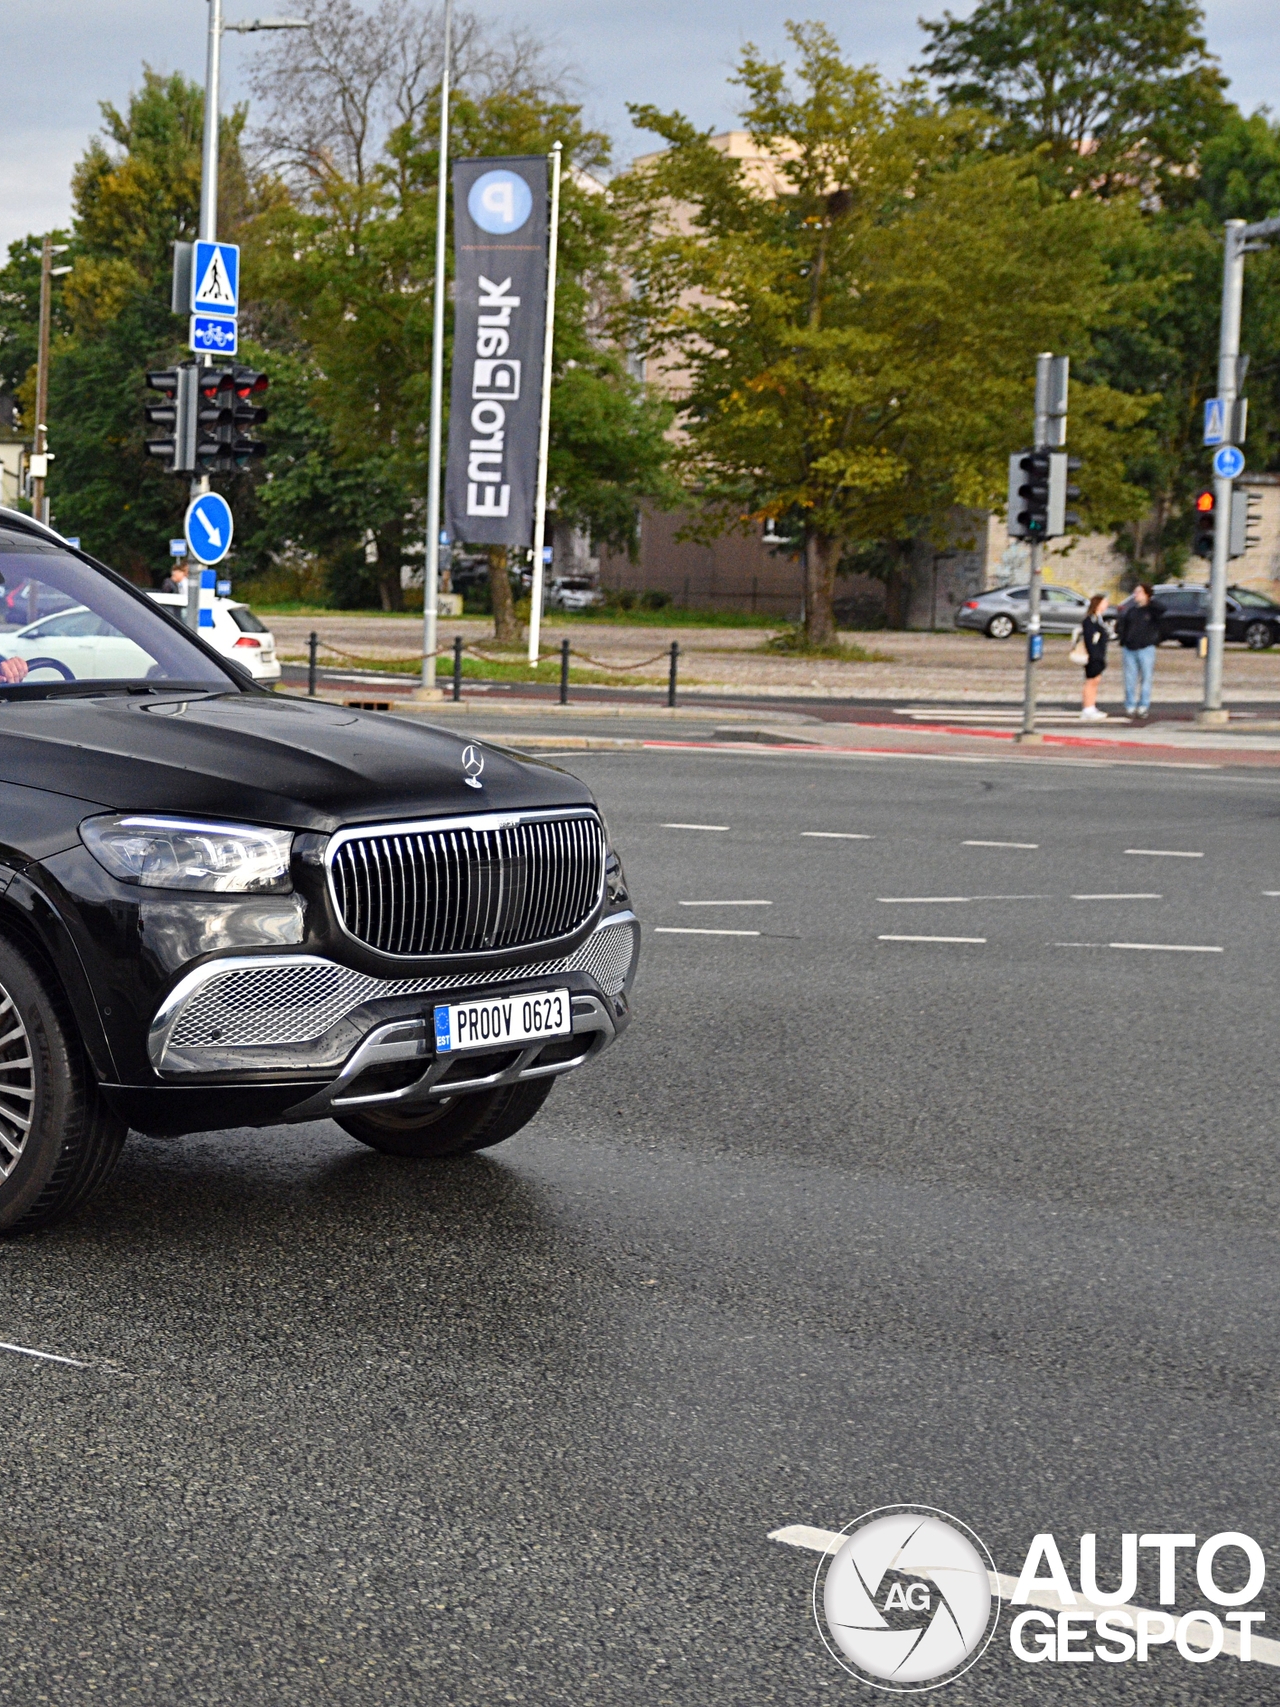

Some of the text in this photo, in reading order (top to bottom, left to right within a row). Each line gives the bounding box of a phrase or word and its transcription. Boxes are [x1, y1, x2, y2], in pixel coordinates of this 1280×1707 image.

[457, 996, 563, 1043] PROOV 0623
[436, 1035, 451, 1047] EST
